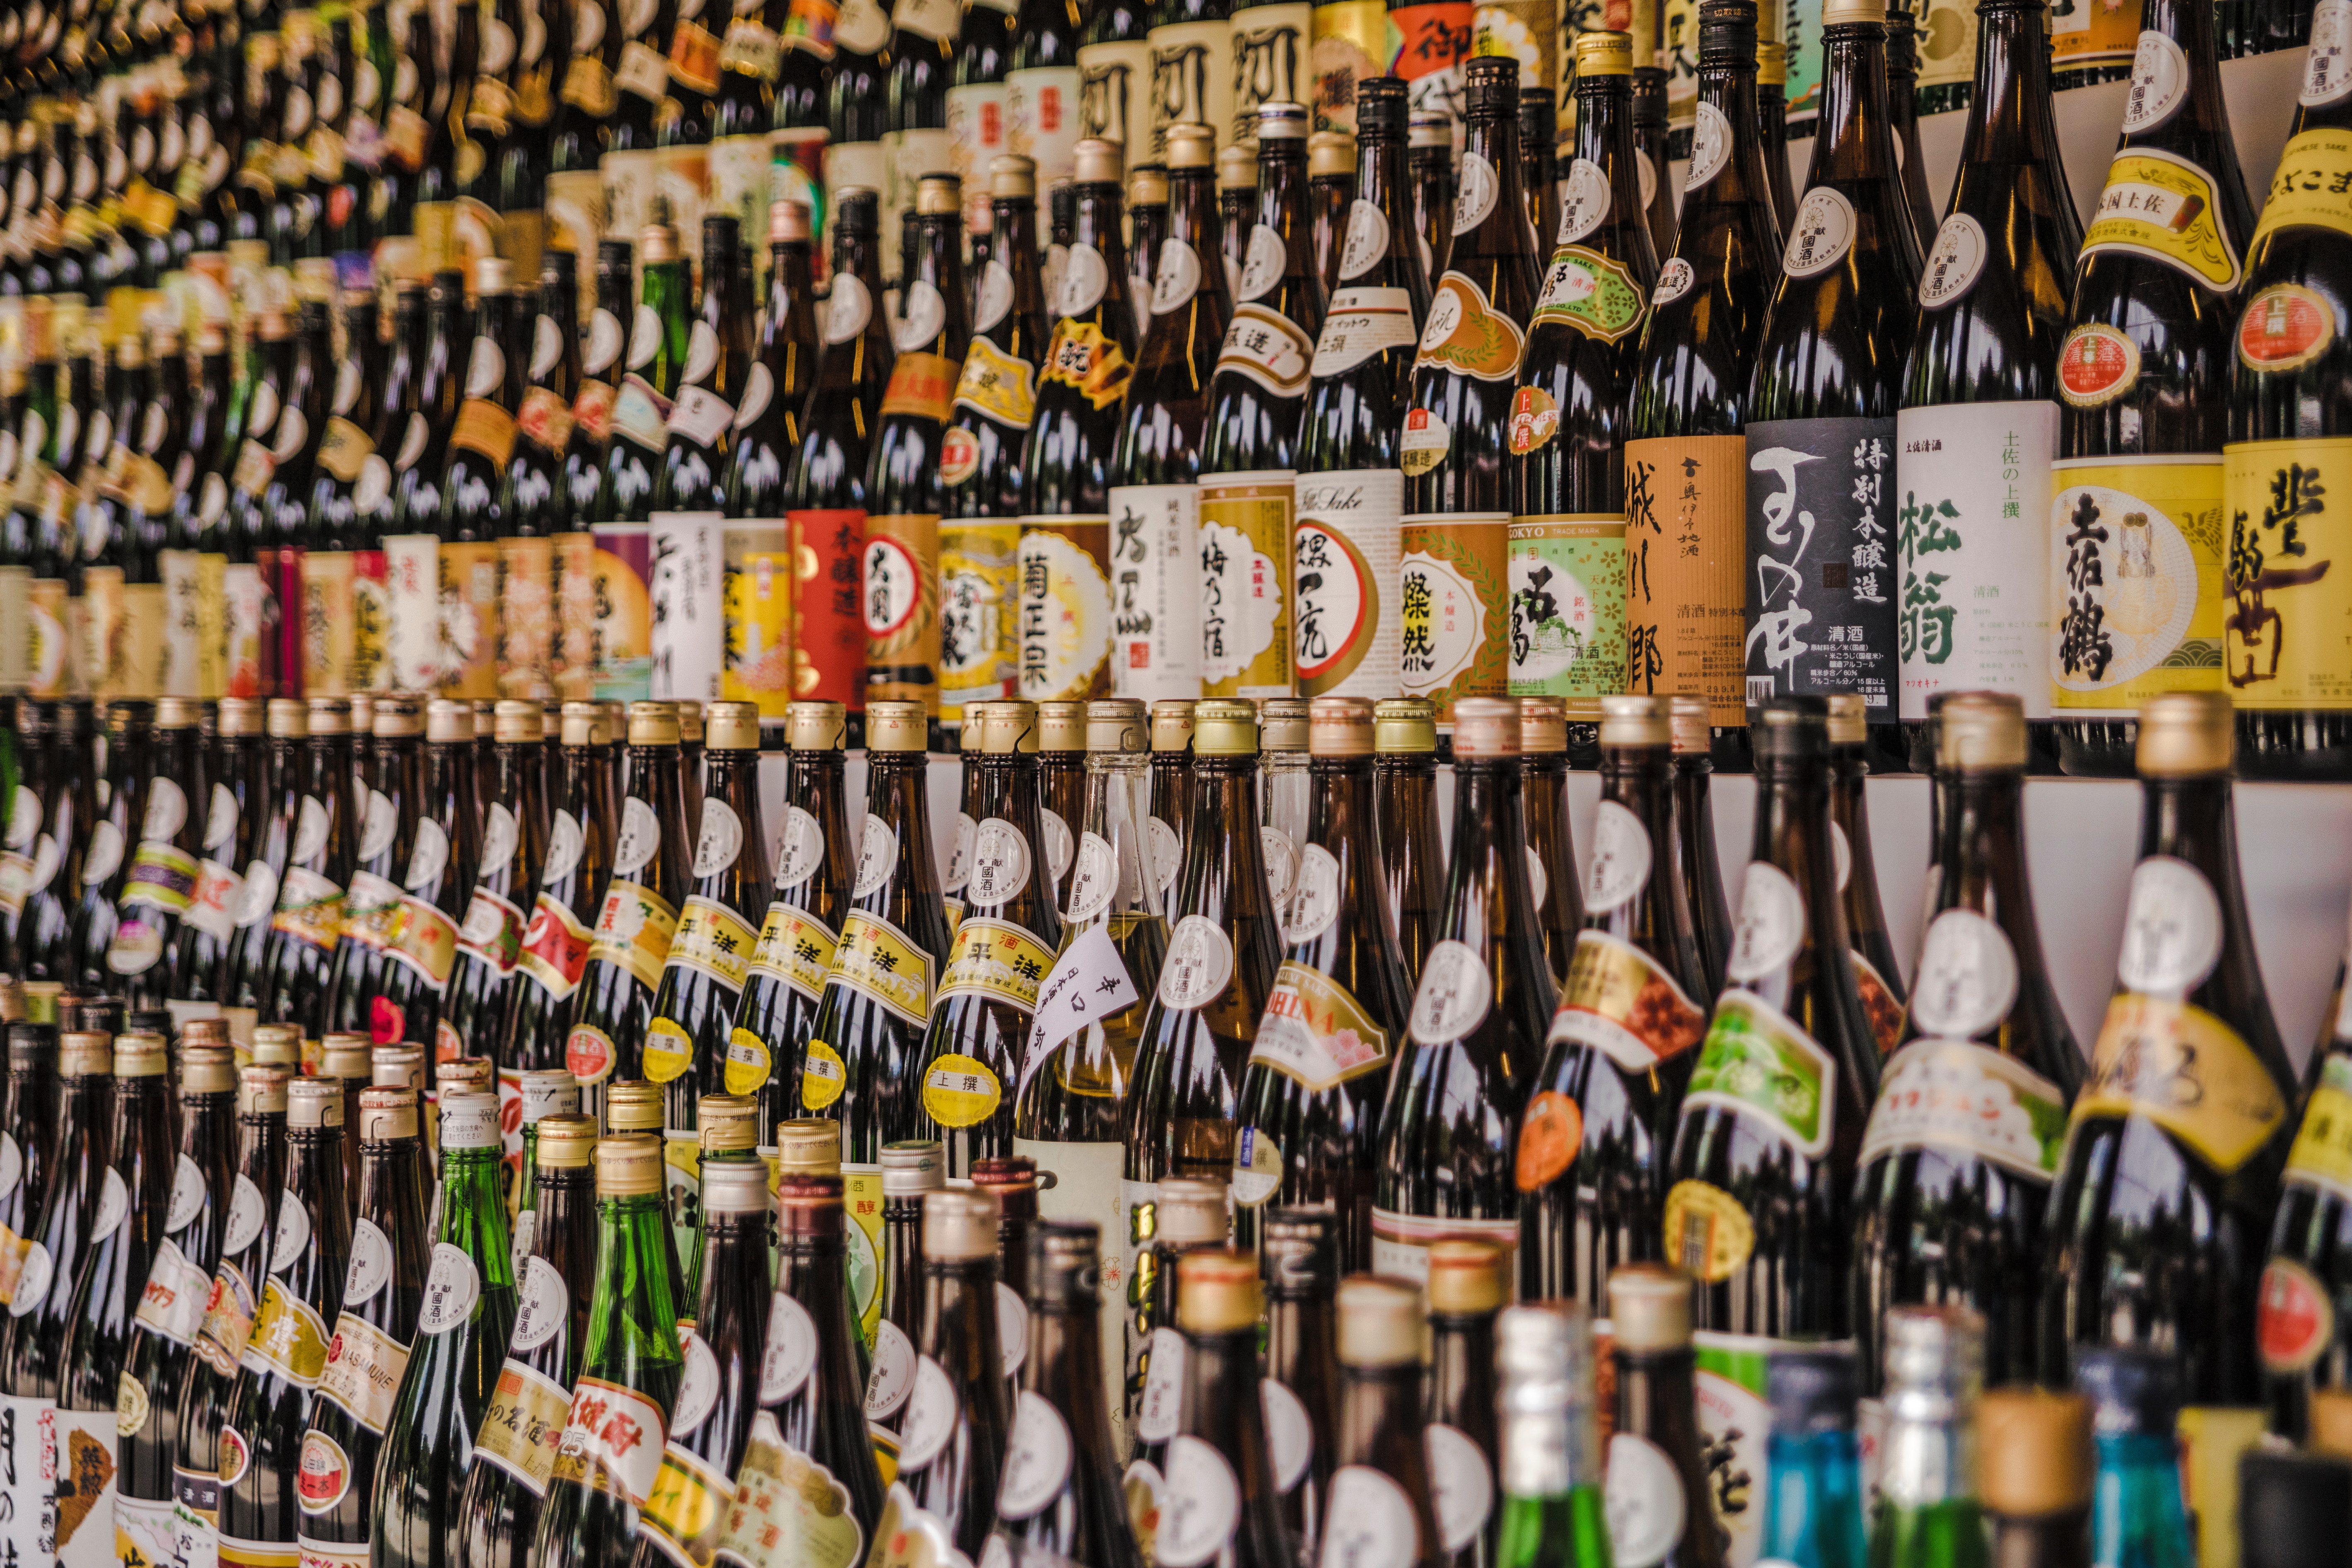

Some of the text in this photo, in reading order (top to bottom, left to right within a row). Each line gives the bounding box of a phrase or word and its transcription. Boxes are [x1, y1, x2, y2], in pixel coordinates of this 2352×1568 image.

[2130, 86, 2145, 115] 國酒
[1799, 227, 1826, 237] 奉献
[1799, 235, 1815, 261] 國酒
[1574, 258, 1594, 270] SAKE
[1934, 255, 1957, 265] 奉献
[1932, 264, 1947, 289] 國酒
[2074, 326, 2113, 337] TOSATSURU
[2083, 337, 2096, 363] 上等
[1906, 439, 1942, 453] 土佐清酒
[2002, 431, 2020, 519] 土佐の上撰
[1852, 438, 1888, 603] 特別本醸造
[1508, 527, 1544, 538] GOKYO
[1898, 490, 1962, 664] 松翁
[2059, 493, 2113, 682] 土佐鶴
[1590, 575, 1600, 613] 天下之
[1973, 586, 2000, 598] 清酒
[1574, 596, 1585, 621] 銘酒
[1677, 603, 1705, 618] 清酒
[1024, 552, 1049, 689] 菊正宗
[1828, 626, 1863, 642] 清酒
[1571, 646, 1599, 659] 清酒
[1906, 678, 1939, 688] マツオキナ
[978, 858, 1004, 867] 奉献
[980, 866, 994, 890] 國酒
[957, 931, 1020, 950] 清酒
[1174, 956, 1202, 967] 奉献
[1175, 967, 1192, 993] 國酒
[944, 1060, 972, 1073] 日本酒
[938, 1073, 977, 1091] 上撰
[934, 1108, 974, 1124] 熊野の地酒
[1242, 1131, 1254, 1164] 清酒
[857, 1200, 876, 1215] 醇
[430, 1284, 452, 1293] 奉献
[430, 1292, 442, 1317] 國酒
[518, 1307, 531, 1333] 國酒
[363, 1336, 381, 1352] SAKE
[341, 1347, 393, 1389] MASAMUNE
[867, 1374, 880, 1402] 國酒
[560, 1431, 586, 1457] 25
[520, 1454, 550, 1480] 上撰
